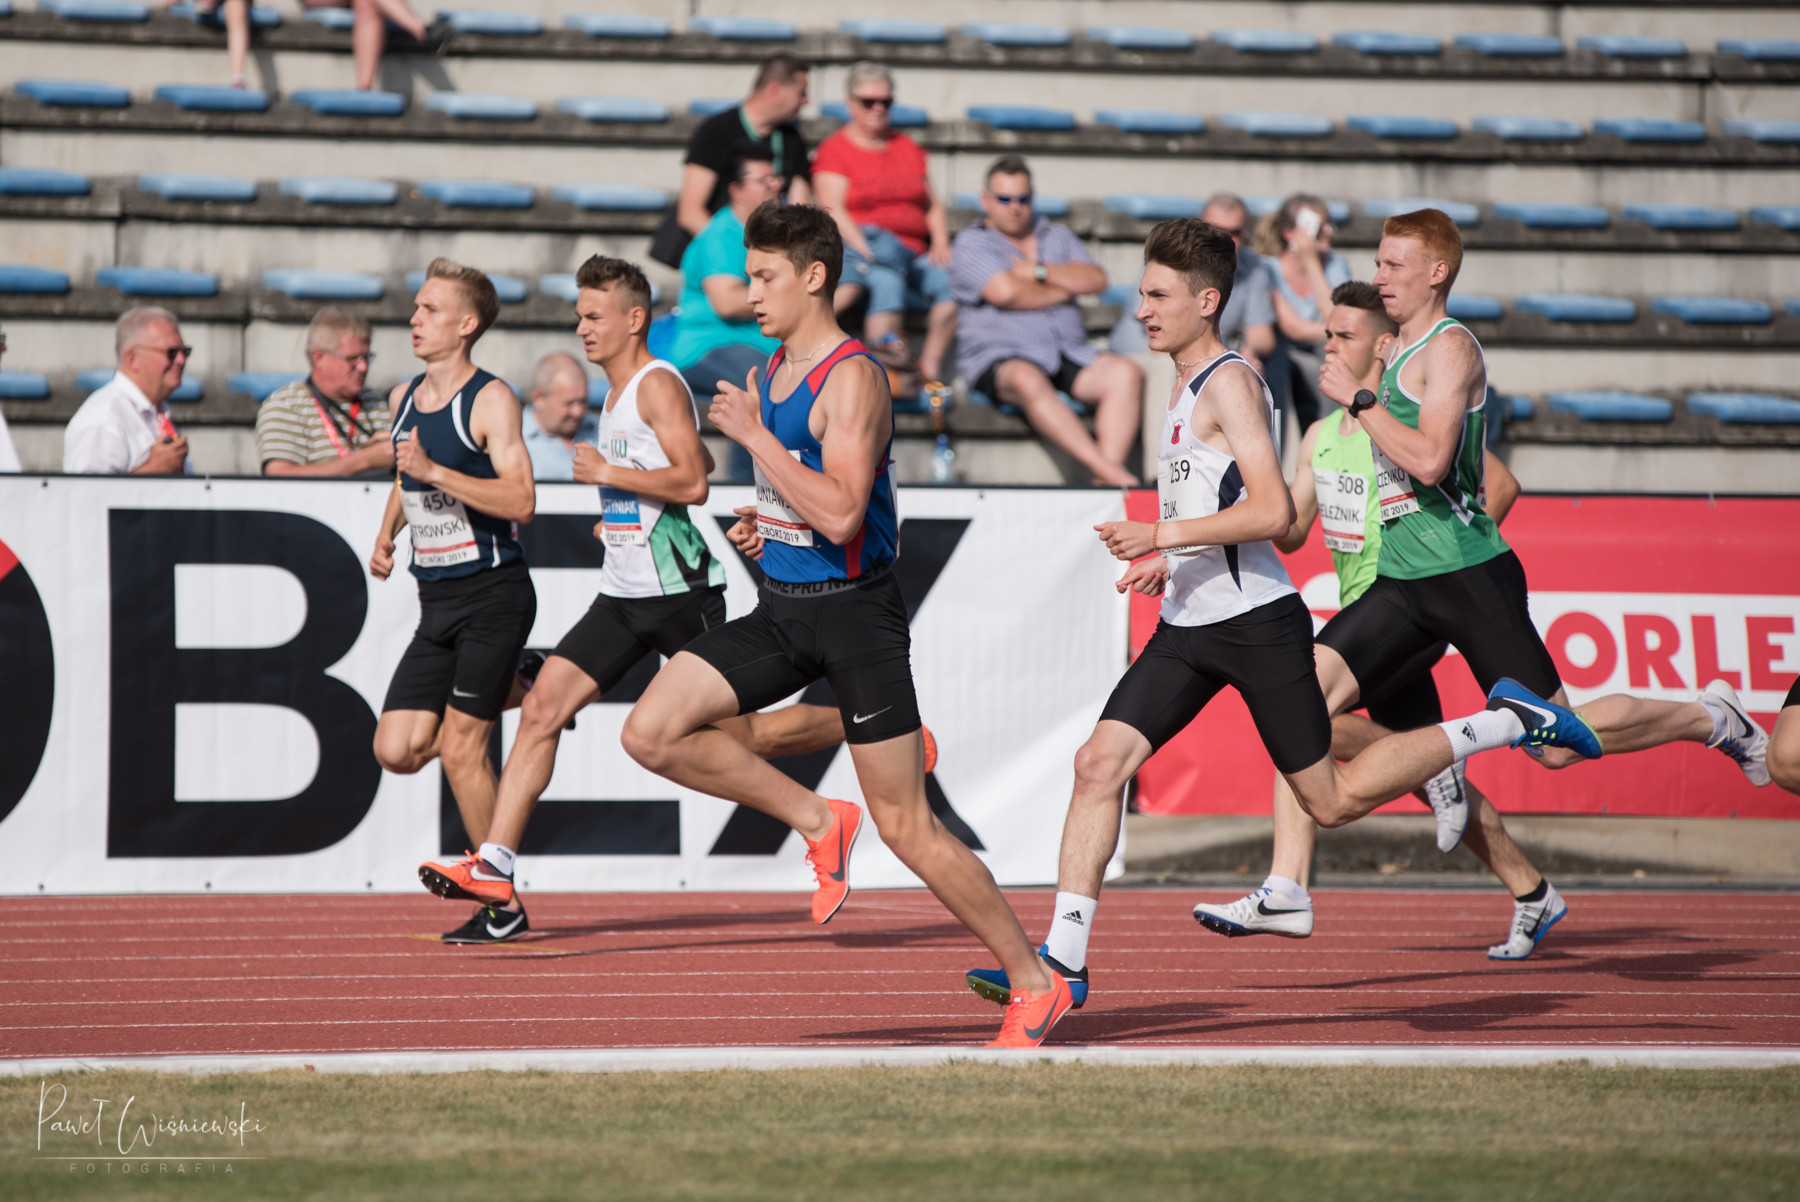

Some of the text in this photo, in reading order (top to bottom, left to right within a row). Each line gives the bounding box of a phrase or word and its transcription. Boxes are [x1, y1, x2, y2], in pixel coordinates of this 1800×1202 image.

[1170, 459, 1191, 484] 259
[1337, 475, 1364, 495] 508
[423, 491, 457, 512] 450
[1163, 499, 1179, 520] ŻUK
[1390, 502, 1409, 516] 2019
[618, 533, 635, 542] 2019
[782, 531, 800, 543] 2019
[447, 550, 467, 562] 2019
